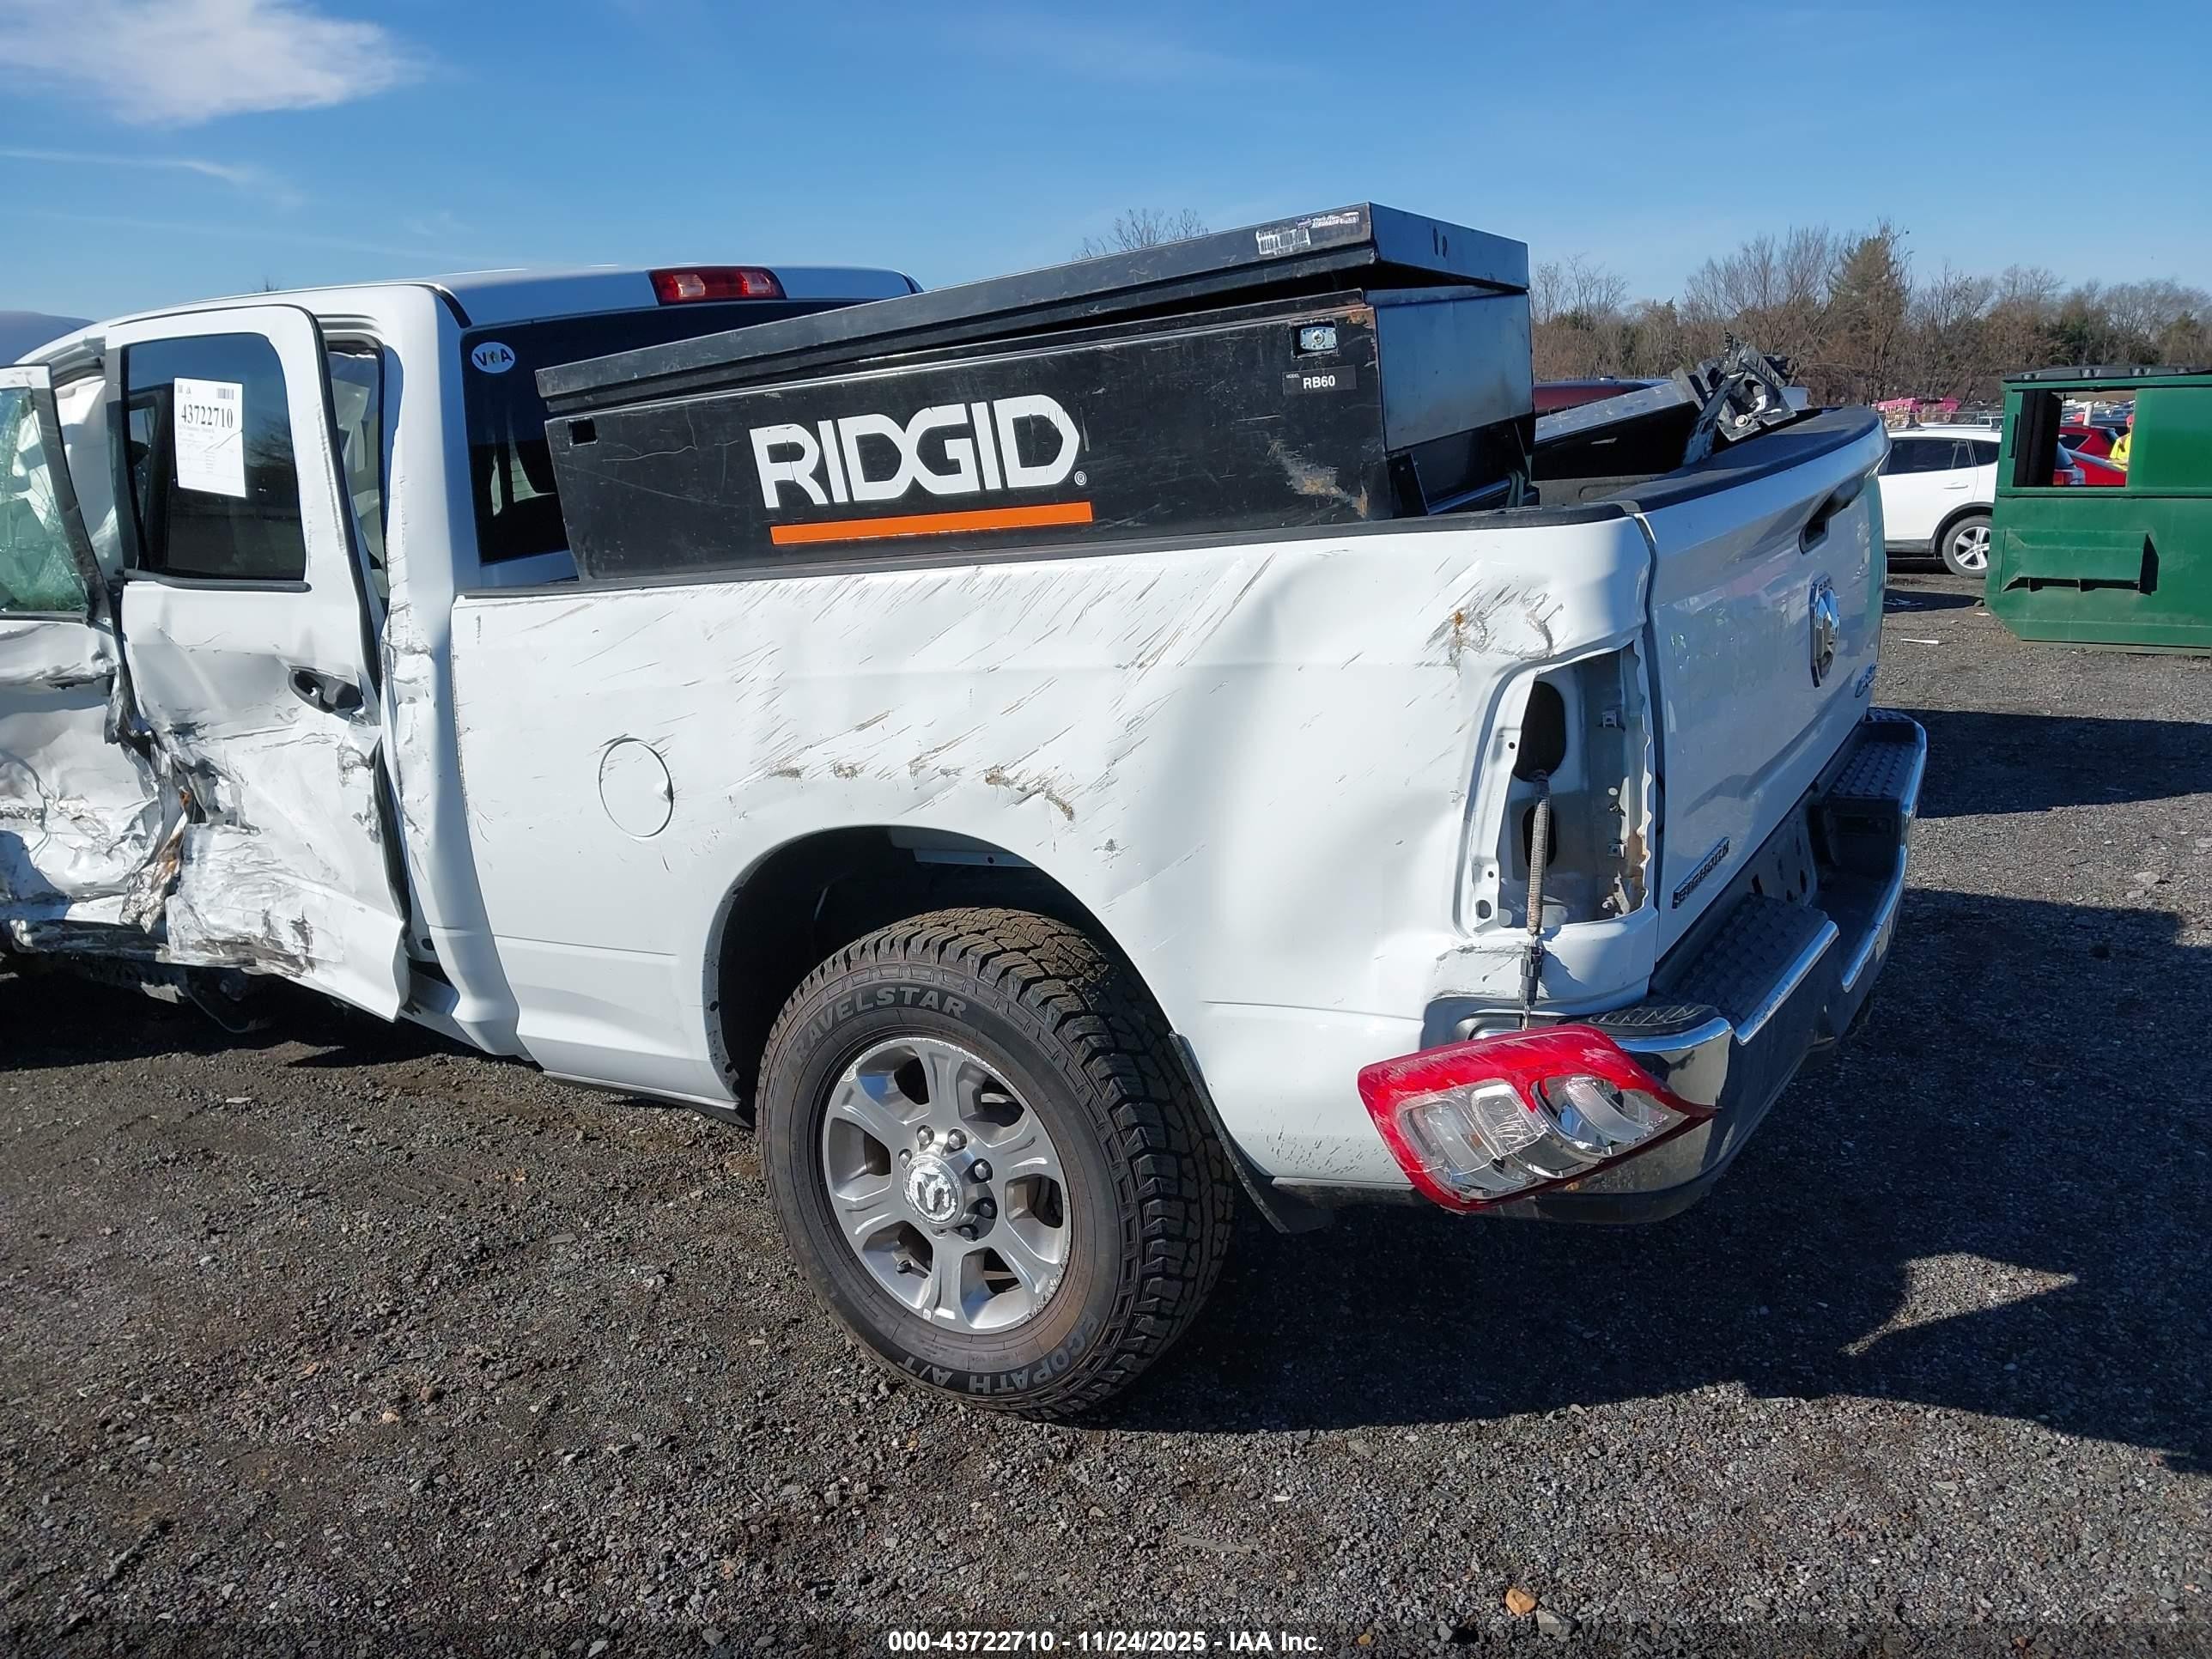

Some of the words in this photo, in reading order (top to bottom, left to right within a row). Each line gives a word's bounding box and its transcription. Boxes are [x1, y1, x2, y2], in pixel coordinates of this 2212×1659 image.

[181, 404, 234, 428] 43722710
[1303, 374, 1336, 389] RB60
[750, 394, 1079, 508] RIDGID
[788, 986, 968, 1072] RAVELSTAR
[968, 1311, 1101, 1395] ECOPATH
